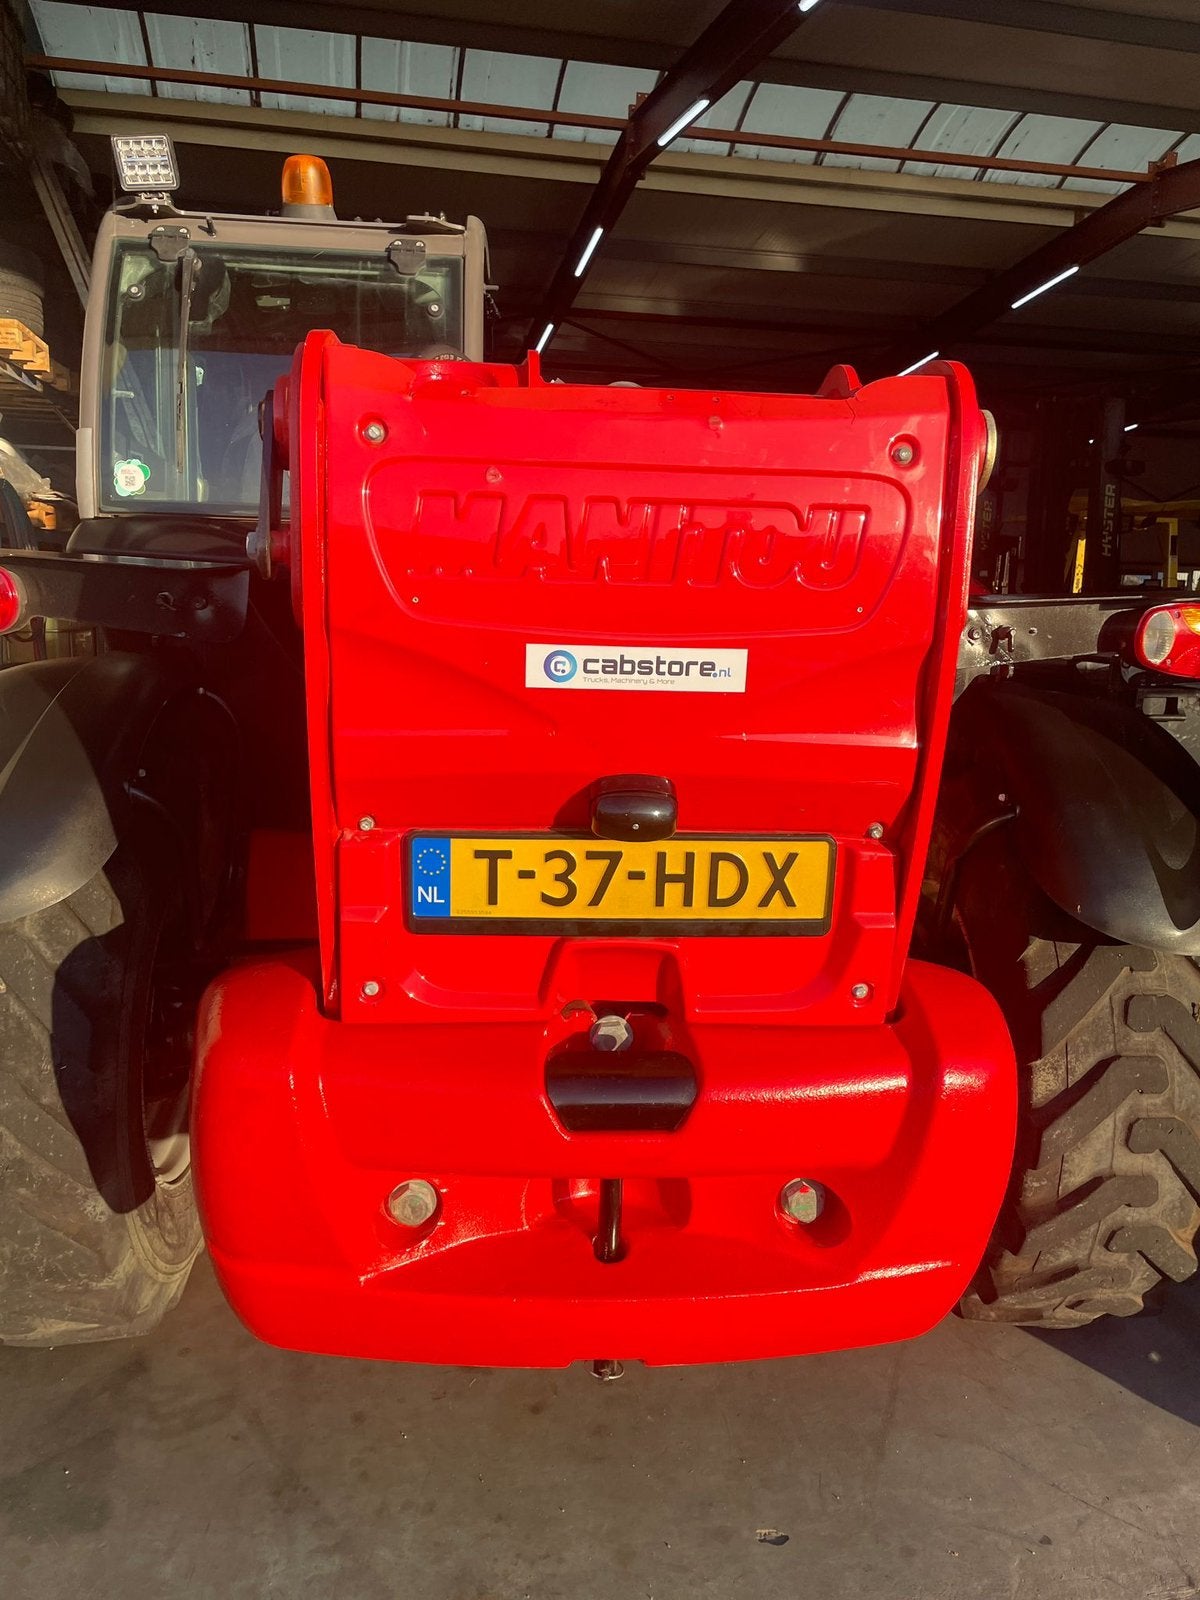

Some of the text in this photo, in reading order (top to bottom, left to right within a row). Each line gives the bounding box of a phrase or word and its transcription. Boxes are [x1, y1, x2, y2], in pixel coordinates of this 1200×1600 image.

[408, 490, 872, 591] MANITOU
[1102, 484, 1116, 557] HYSTER
[582, 654, 732, 678] cabstore.nl
[611, 677, 648, 686] Machinery
[417, 886, 445, 903] NL
[474, 849, 800, 908] T-37-HDX
